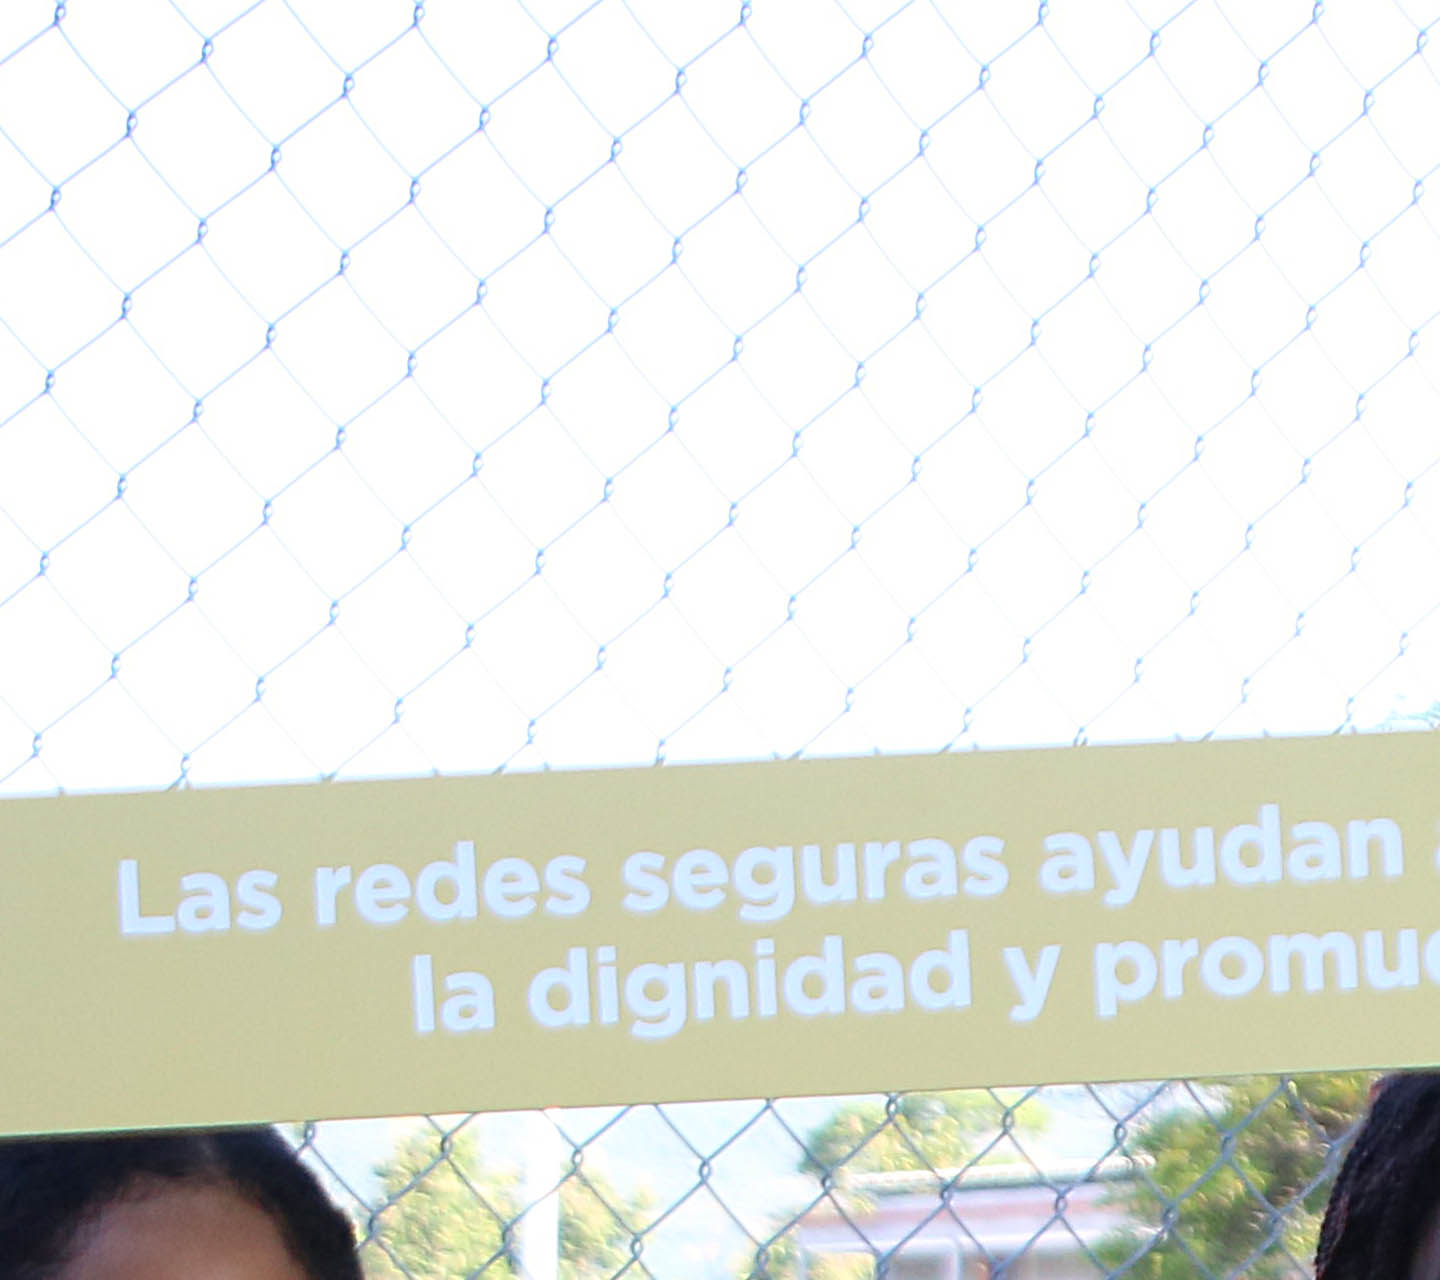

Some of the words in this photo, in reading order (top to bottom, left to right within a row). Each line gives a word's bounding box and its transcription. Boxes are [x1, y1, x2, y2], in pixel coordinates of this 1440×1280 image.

[118, 860, 282, 935] Las
[314, 841, 591, 926] redes
[622, 835, 1009, 923] seguras
[1039, 804, 1403, 906] ayudan
[413, 954, 495, 1035] la
[527, 926, 972, 1040] dignidad
[1002, 943, 1061, 1022] y
